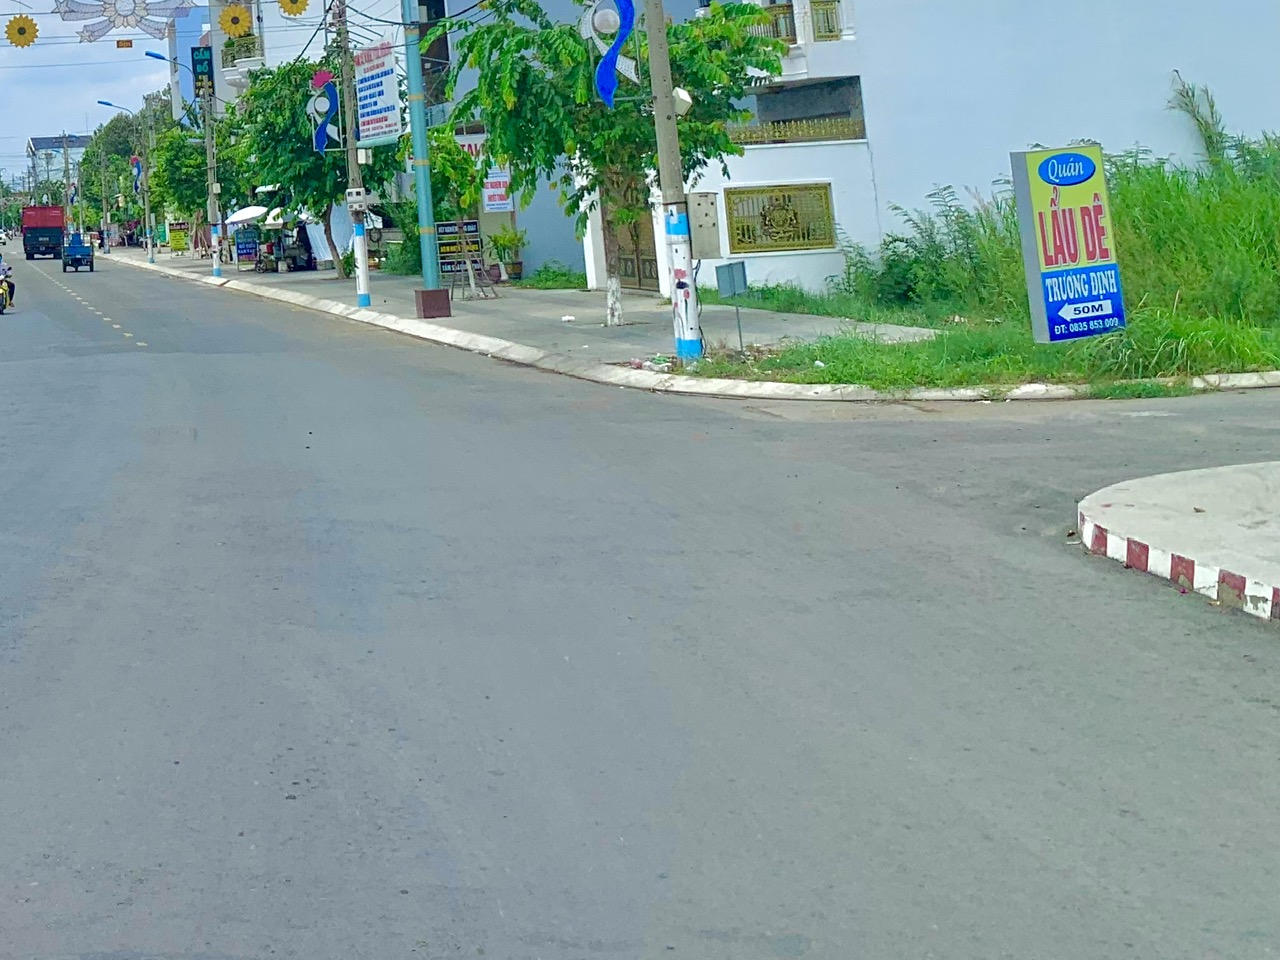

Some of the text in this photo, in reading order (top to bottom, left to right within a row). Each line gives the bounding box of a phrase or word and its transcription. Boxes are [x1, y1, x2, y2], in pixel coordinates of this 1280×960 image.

[1048, 158, 1085, 183] Quán
[1037, 185, 1112, 268] LẨU DÊ
[1089, 269, 1117, 300] ĐỊNH
[1073, 302, 1104, 315] 50M
[1054, 325, 1068, 335] ĐT:
[1069, 323, 1088, 333] 0835
